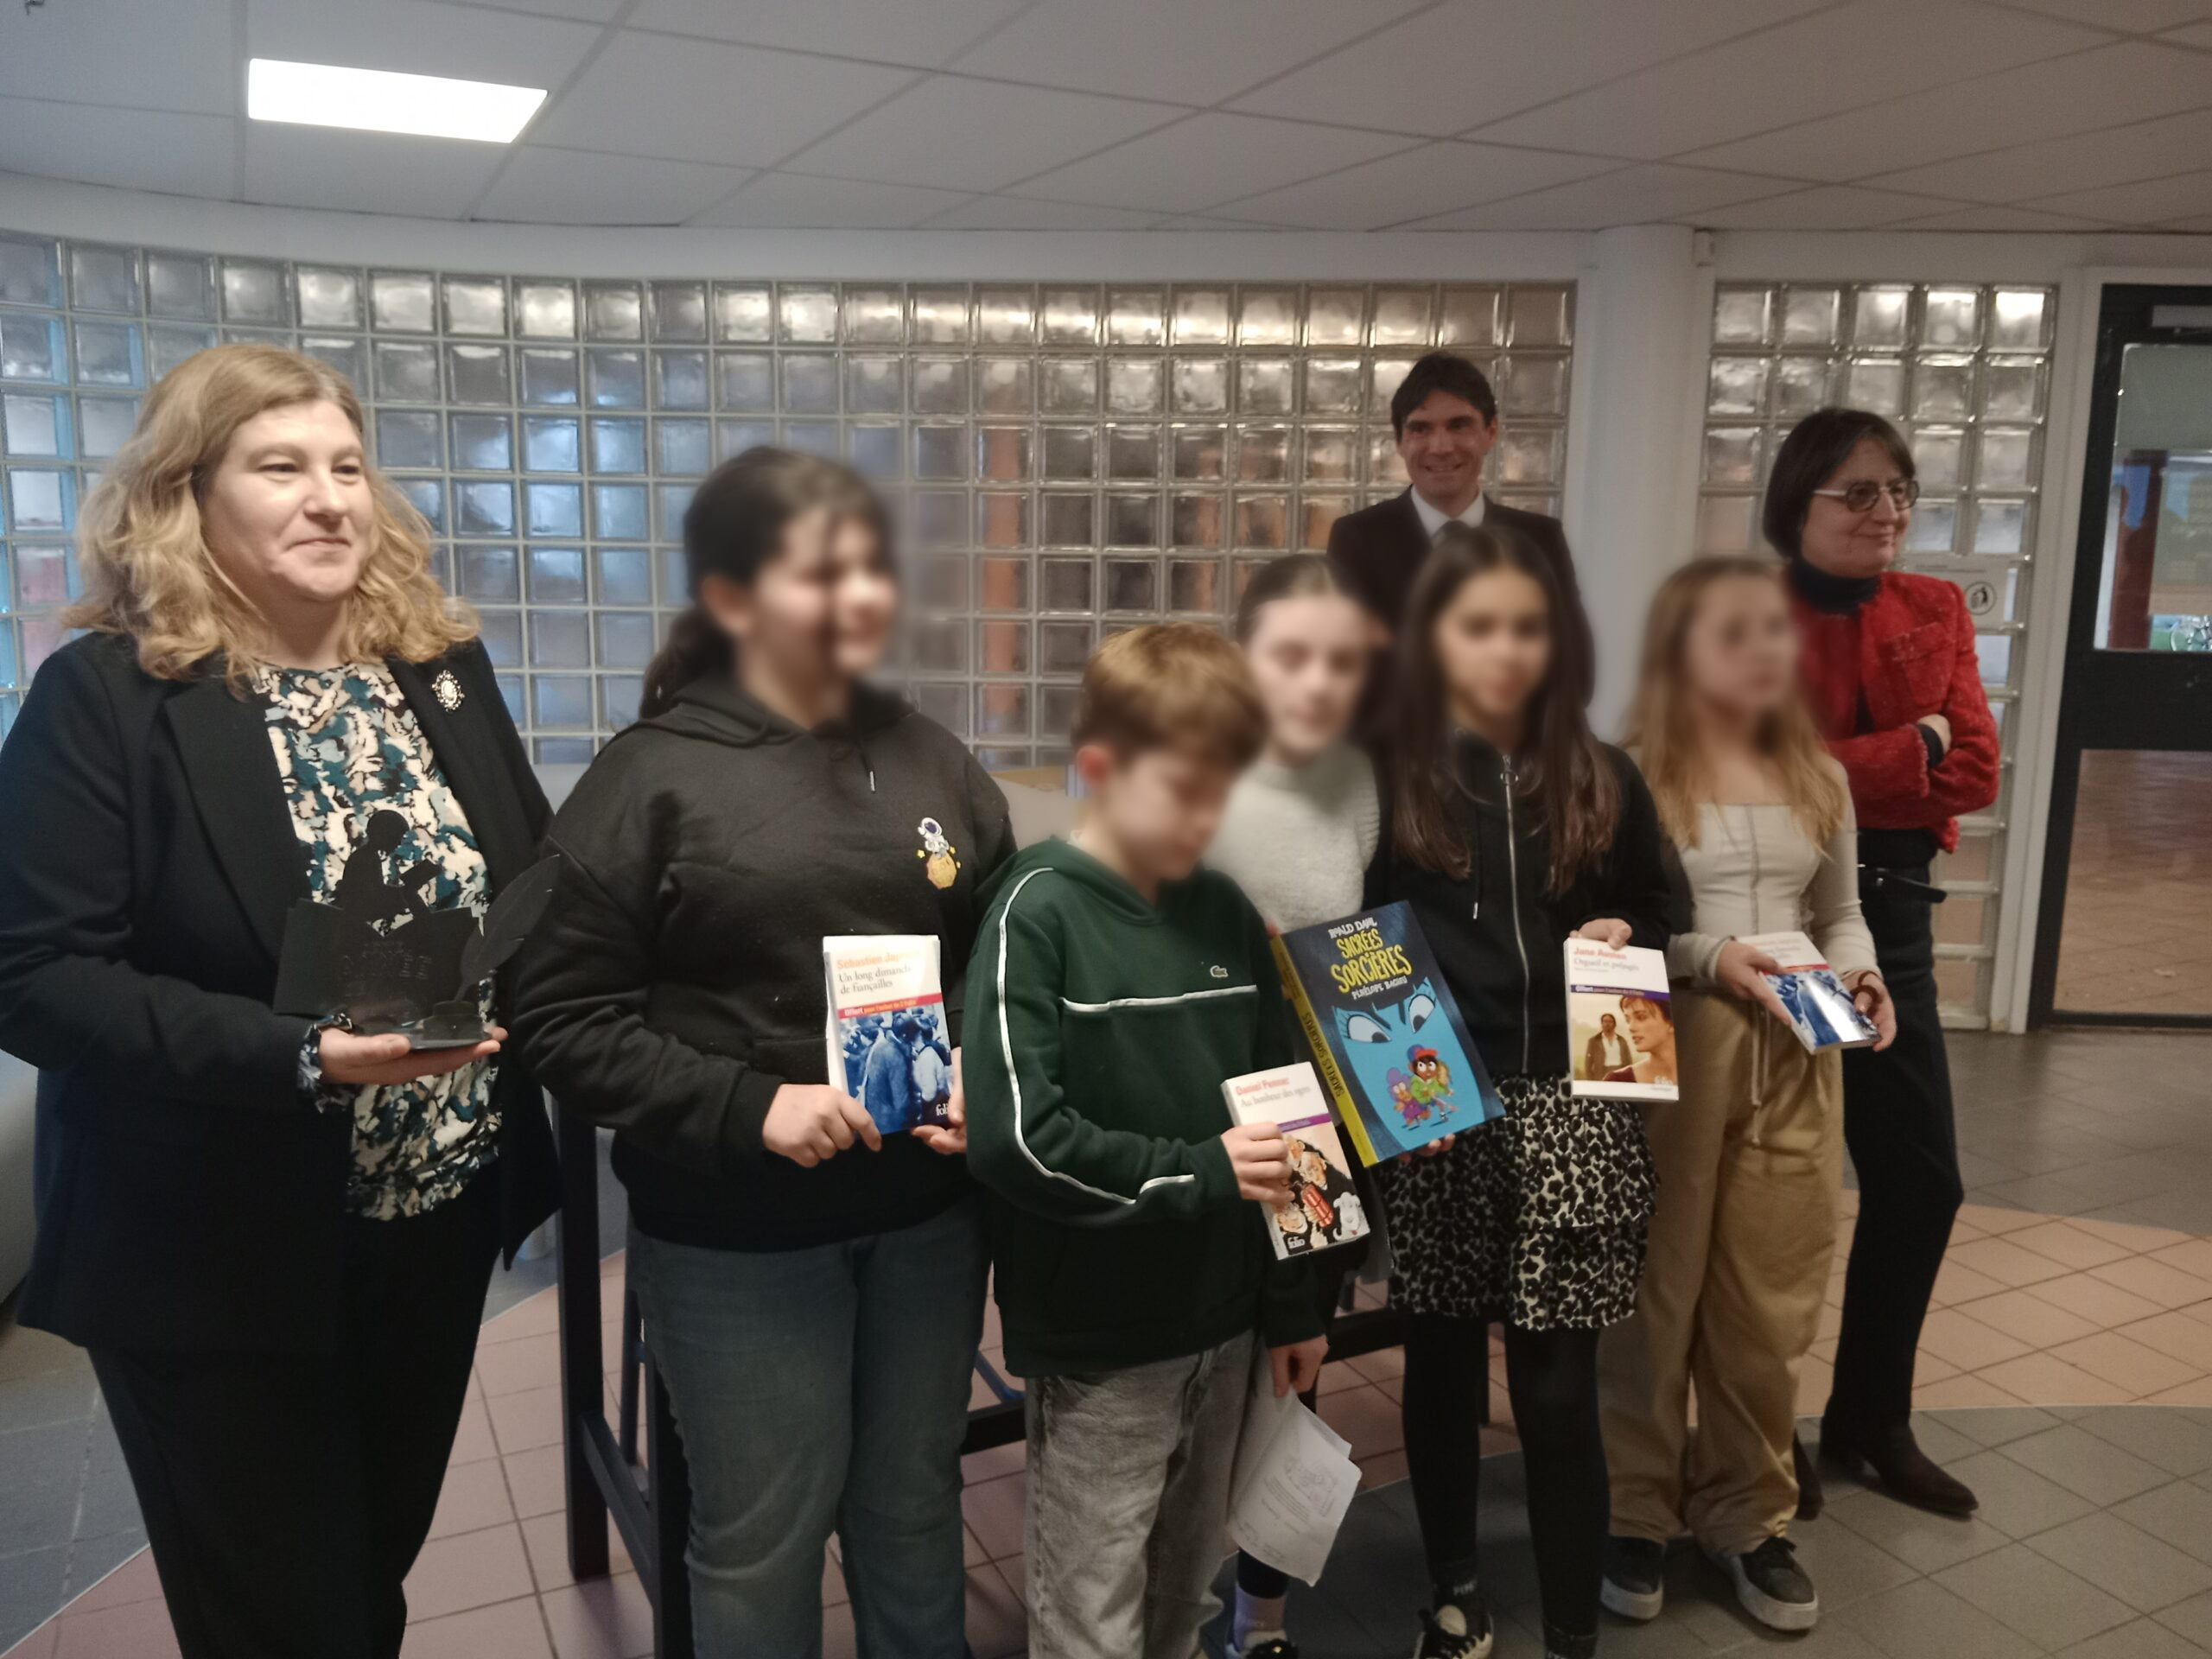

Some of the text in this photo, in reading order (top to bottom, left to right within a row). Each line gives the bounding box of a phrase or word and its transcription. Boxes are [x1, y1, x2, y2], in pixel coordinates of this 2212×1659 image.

[1328, 918, 1378, 939] ROALD DAHL
[1337, 928, 1383, 959] SACRÉES
[1573, 948, 1595, 957] Jane
[838, 973, 853, 982] Un
[854, 969, 874, 982] long
[1331, 944, 1413, 994] SORCIÈRES
[840, 977, 894, 995] de fiançailles
